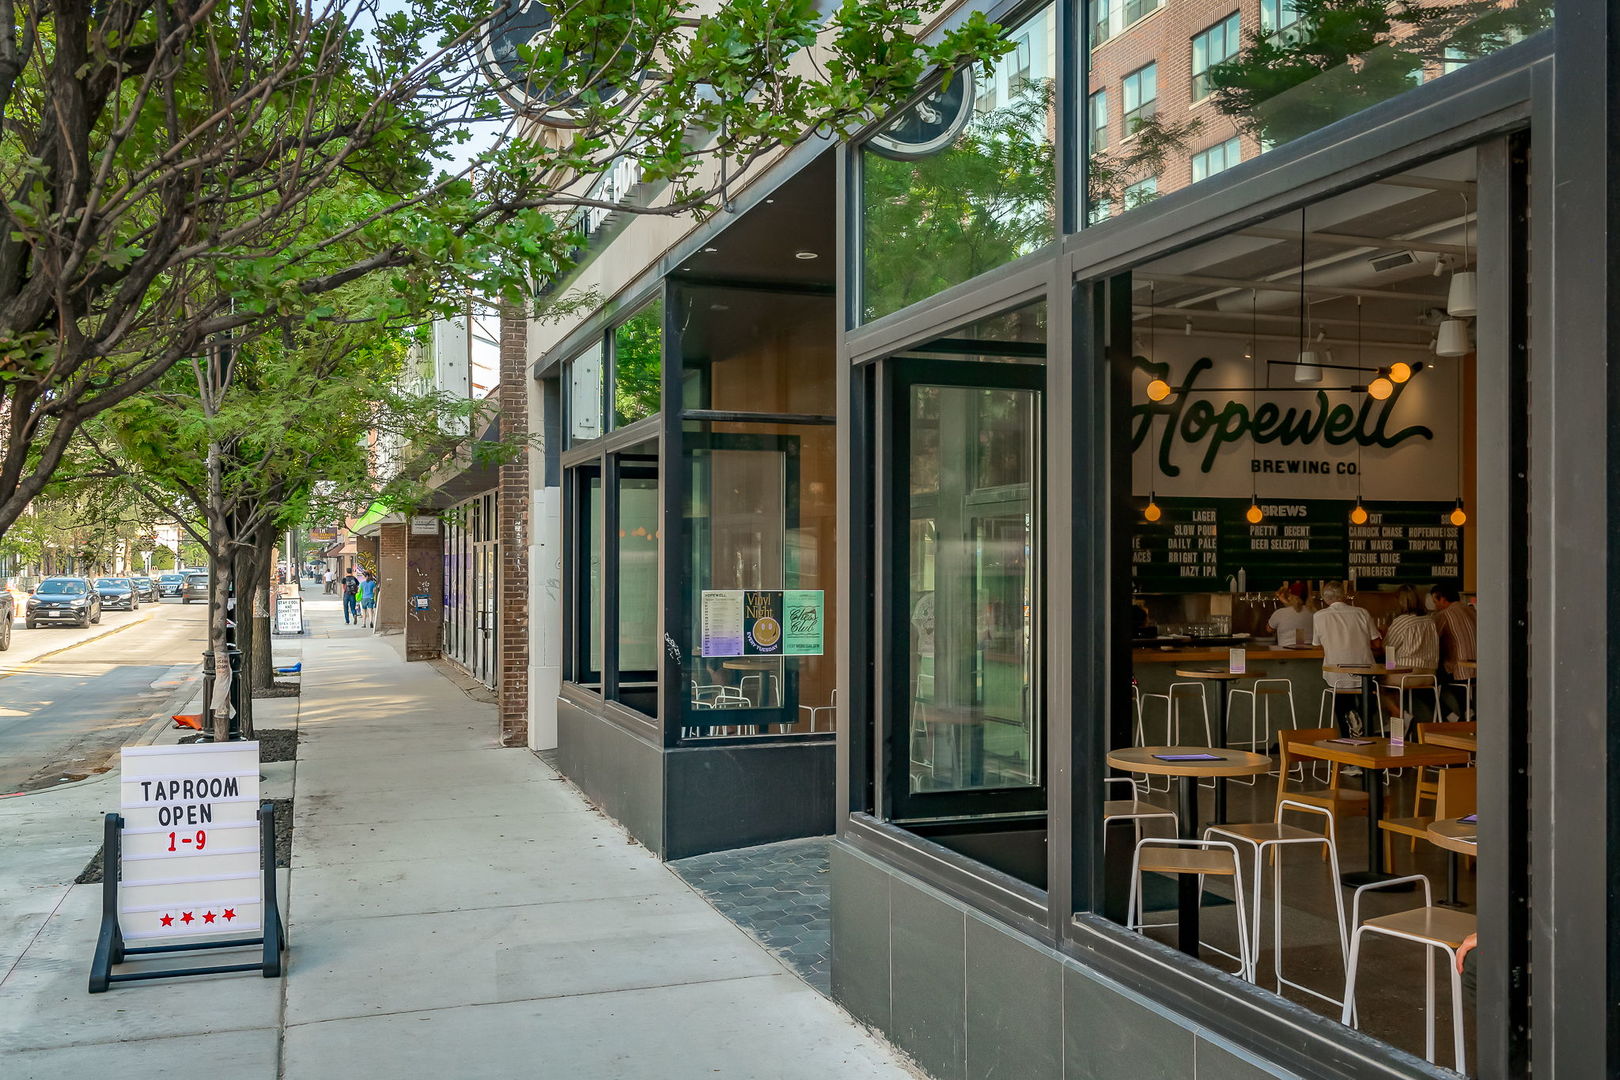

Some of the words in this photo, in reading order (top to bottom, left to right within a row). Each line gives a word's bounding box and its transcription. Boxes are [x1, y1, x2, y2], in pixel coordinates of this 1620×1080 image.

[1131, 357, 1433, 477] Hopewell
[1251, 460, 1330, 475] BREWING
[1336, 462, 1361, 475] CO.
[1192, 511, 1216, 521] LAGER
[1261, 505, 1308, 517] BREWS
[1174, 525, 1195, 535] SLOW
[1250, 526, 1278, 536] PRETTY
[1284, 526, 1310, 536] DECENT
[1168, 538, 1192, 549] DAILY
[1198, 538, 1217, 549] PALE
[1271, 539, 1309, 550] SELECTION
[1370, 540, 1393, 550] WAVES
[1409, 540, 1441, 550] TROPICAL
[1445, 540, 1458, 550] IPA
[1168, 552, 1198, 562] BRIGHT
[1203, 552, 1217, 562] IPA
[1349, 553, 1377, 563] OUTSIDE
[1380, 553, 1401, 563] VOICE
[1444, 553, 1458, 563] XPA
[1180, 566, 1199, 576] HAZY
[1203, 566, 1217, 576] IPA
[746, 593, 771, 606] Vinyl
[746, 606, 773, 619] Night
[756, 644, 778, 652] TUESDAY
[141, 777, 239, 801] TAPROOM
[158, 804, 212, 826] OPEN
[168, 830, 207, 852] 1-9
